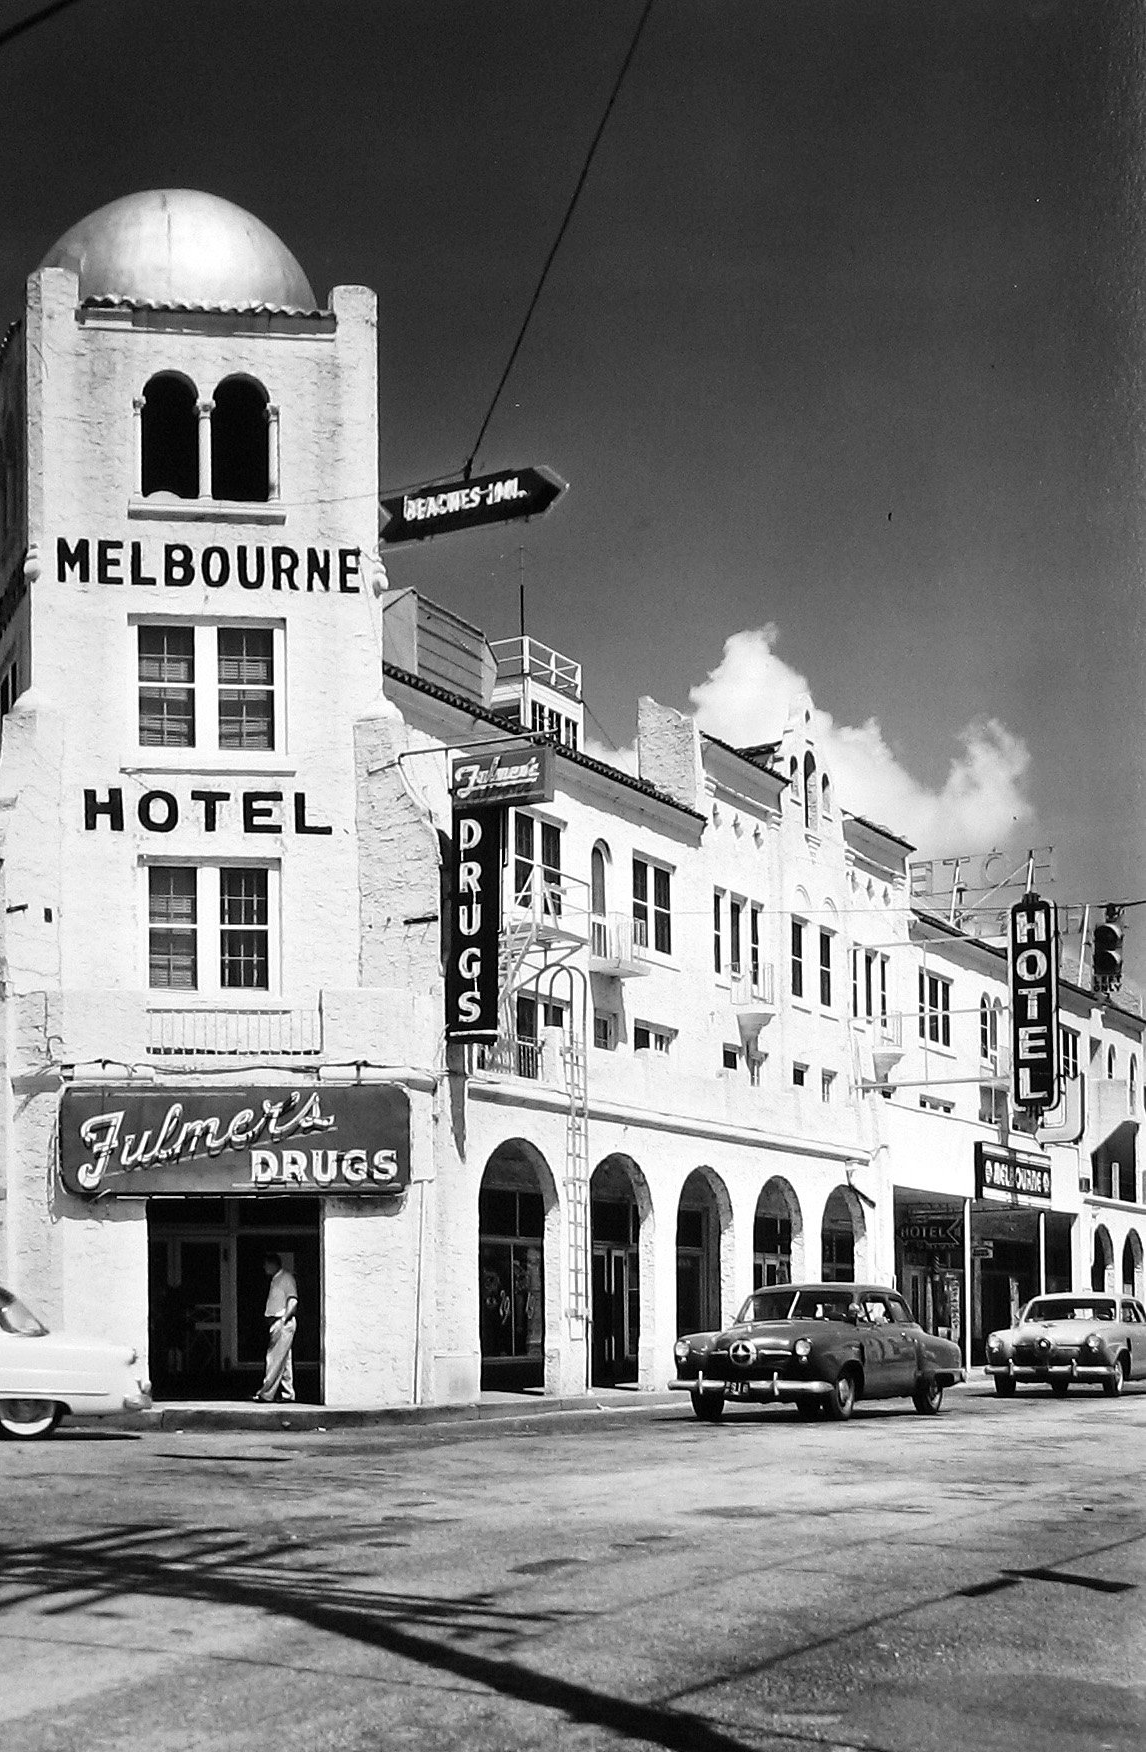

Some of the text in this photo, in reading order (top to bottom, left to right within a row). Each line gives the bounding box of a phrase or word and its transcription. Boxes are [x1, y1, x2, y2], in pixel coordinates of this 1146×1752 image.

[56, 536, 360, 593] MELBOURNE
[83, 788, 333, 834] HOTEL
[458, 818, 483, 1024] DRUGS
[1015, 910, 1049, 1100] HOTEL
[78, 1091, 336, 1189] Fulmer's
[251, 1150, 398, 1182] DRUGS
[900, 1226, 947, 1238] HOTEL
